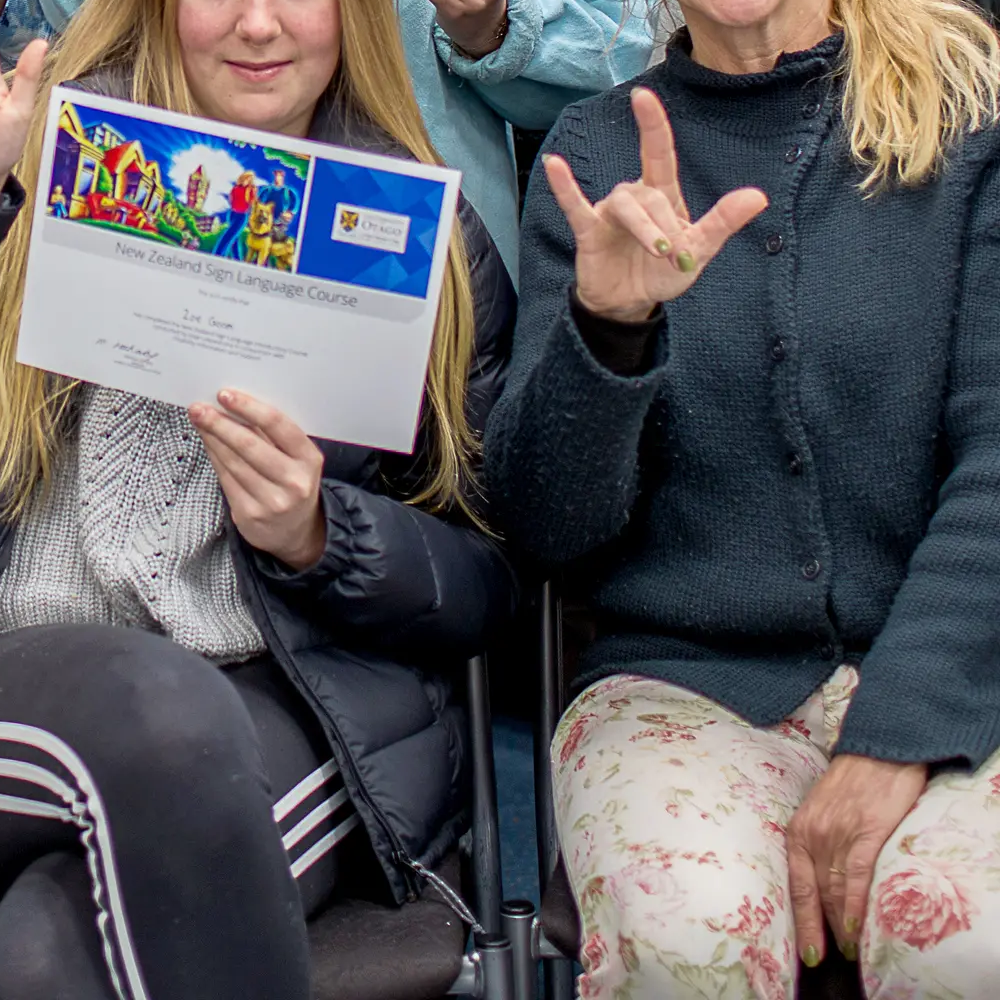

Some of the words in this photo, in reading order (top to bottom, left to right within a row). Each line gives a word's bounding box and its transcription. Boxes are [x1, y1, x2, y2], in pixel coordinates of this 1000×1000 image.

[115, 242, 145, 260] New
[148, 250, 202, 274] Zealand
[204, 263, 234, 283] Sign
[237, 270, 304, 298] Language
[307, 286, 358, 308] Course
